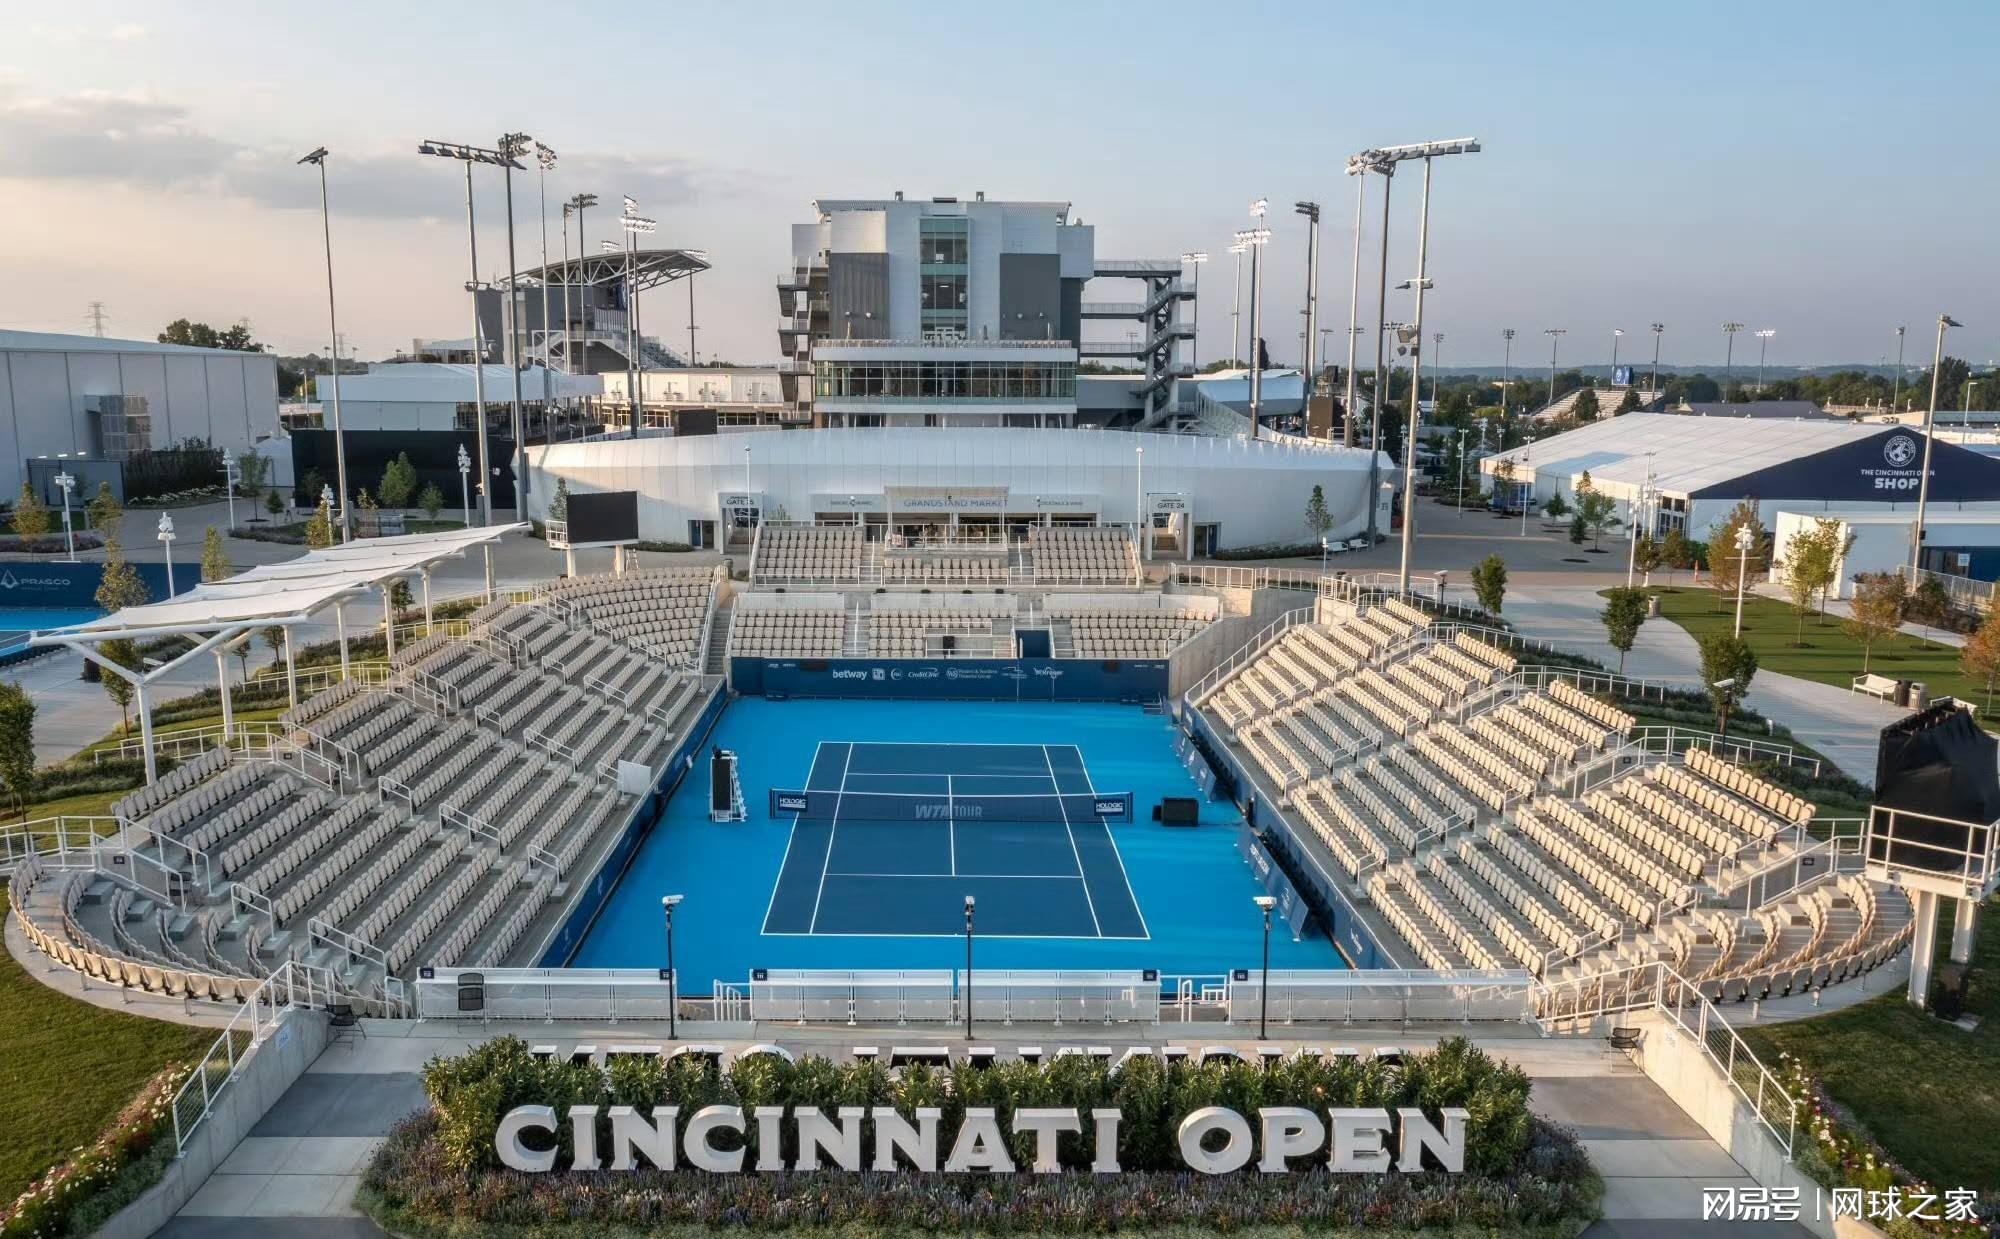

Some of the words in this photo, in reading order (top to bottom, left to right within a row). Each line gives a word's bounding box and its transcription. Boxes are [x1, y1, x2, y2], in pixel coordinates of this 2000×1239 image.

[1874, 478, 1919, 489] SHOP
[832, 669, 867, 680] betway
[916, 805, 949, 818] WTA
[954, 806, 982, 816] TOUR
[495, 1104, 1122, 1173] CINCINNATI
[1178, 1106, 1471, 1174] OPEN
